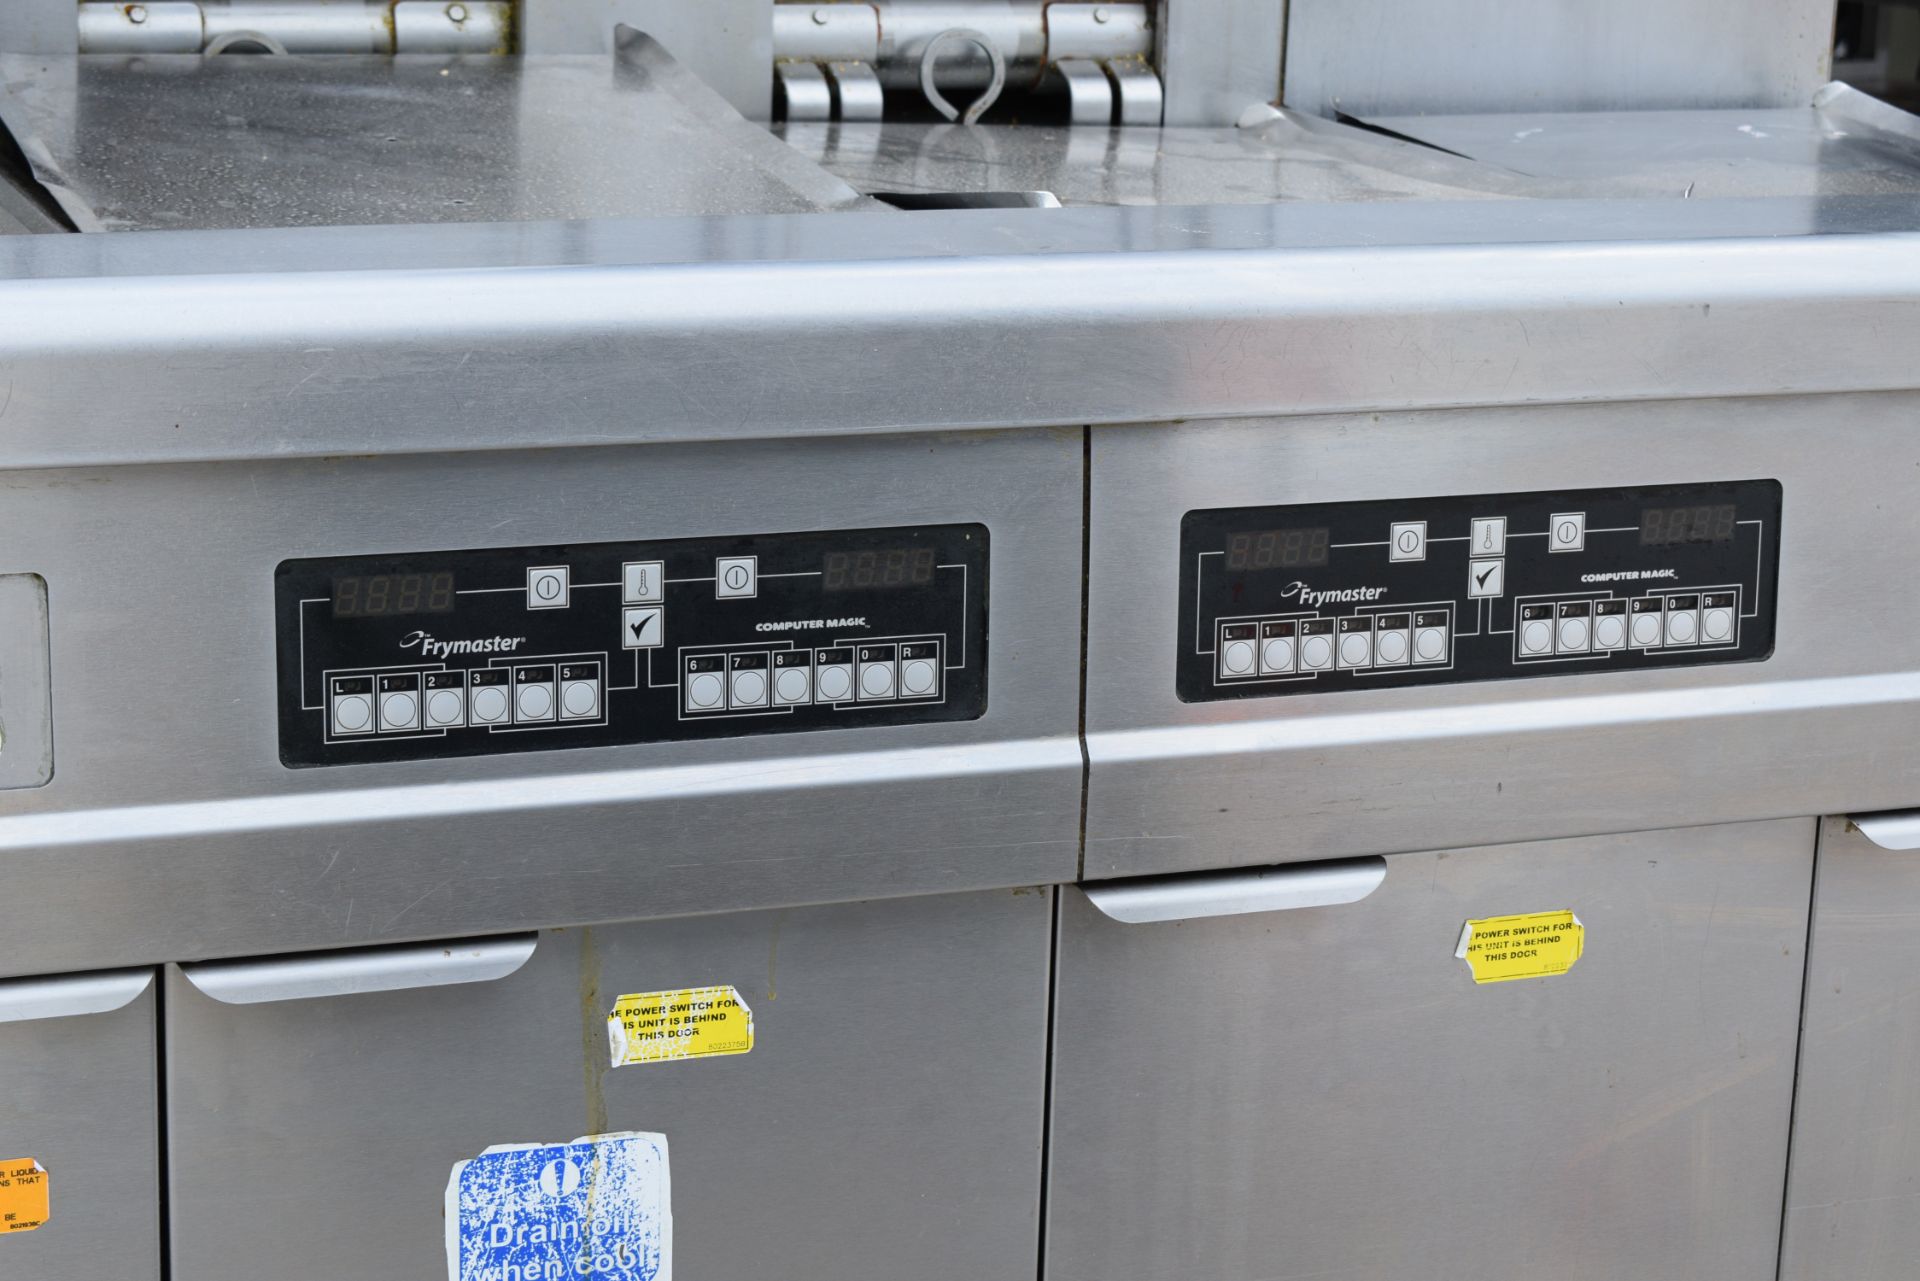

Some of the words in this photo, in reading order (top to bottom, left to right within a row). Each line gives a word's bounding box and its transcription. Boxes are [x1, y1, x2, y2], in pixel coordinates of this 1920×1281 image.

[1581, 571, 1640, 583] COMPUTER
[1641, 568, 1675, 579] MAGIC
[1523, 607, 1531, 618] 6
[1560, 605, 1567, 616] 7
[1597, 603, 1604, 614] 8
[1633, 601, 1640, 612] 9
[1705, 597, 1712, 607] R
[755, 619, 825, 632] COMPUTER
[826, 617, 866, 628] MAGIC
[1225, 628, 1232, 639] L
[1265, 626, 1270, 636] 1
[1303, 623, 1310, 634] 2
[1341, 621, 1348, 631] 3
[1379, 618, 1386, 628] 4
[1417, 615, 1424, 626] 5
[690, 659, 697, 671] 6
[733, 656, 741, 668] 7
[776, 654, 784, 666] 8
[819, 651, 826, 663] 9
[903, 647, 911, 658] R
[336, 680, 344, 693] L
[382, 679, 389, 690] 1
[428, 675, 436, 687] 2
[473, 673, 481, 684] 3
[518, 670, 526, 681] 4
[563, 667, 571, 679] 5
[1475, 929, 1510, 940] POWER
[1512, 925, 1550, 936] SWITCH
[1553, 922, 1573, 931] FOR
[1485, 941, 1510, 951] UNIT
[1512, 940, 1521, 948] IS
[1524, 935, 1561, 946] BEHIND
[1485, 952, 1507, 962] THIS
[625, 1006, 667, 1017] POWER
[670, 1002, 713, 1013] SWITCH
[717, 999, 739, 1009] FOR
[638, 1018, 667, 1029] UNIT
[669, 1016, 680, 1026] IS
[684, 1013, 727, 1024] BEHIND
[638, 1031, 664, 1041] THIS
[668, 1028, 700, 1038] DOOR
[16, 1176, 41, 1185] THAT
[4, 1213, 17, 1221] BE
[490, 1218, 579, 1248] Drain
[591, 1212, 630, 1236] oil
[472, 1257, 564, 1281] when
[575, 1243, 645, 1275] cool
